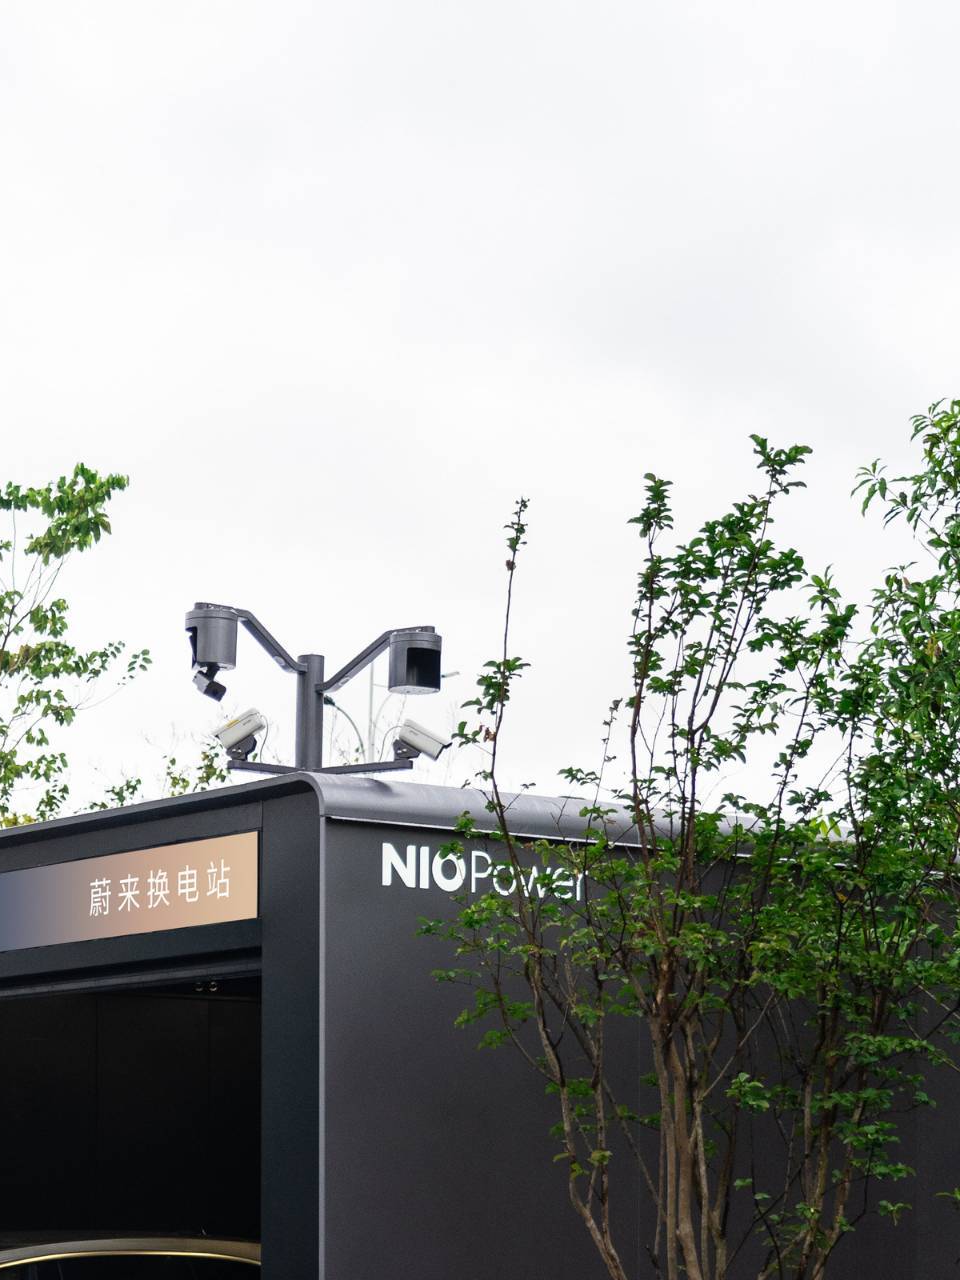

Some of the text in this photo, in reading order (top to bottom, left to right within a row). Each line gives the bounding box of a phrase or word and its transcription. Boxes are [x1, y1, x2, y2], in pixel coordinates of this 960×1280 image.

[89, 859, 231, 918] 蔚来换电站
